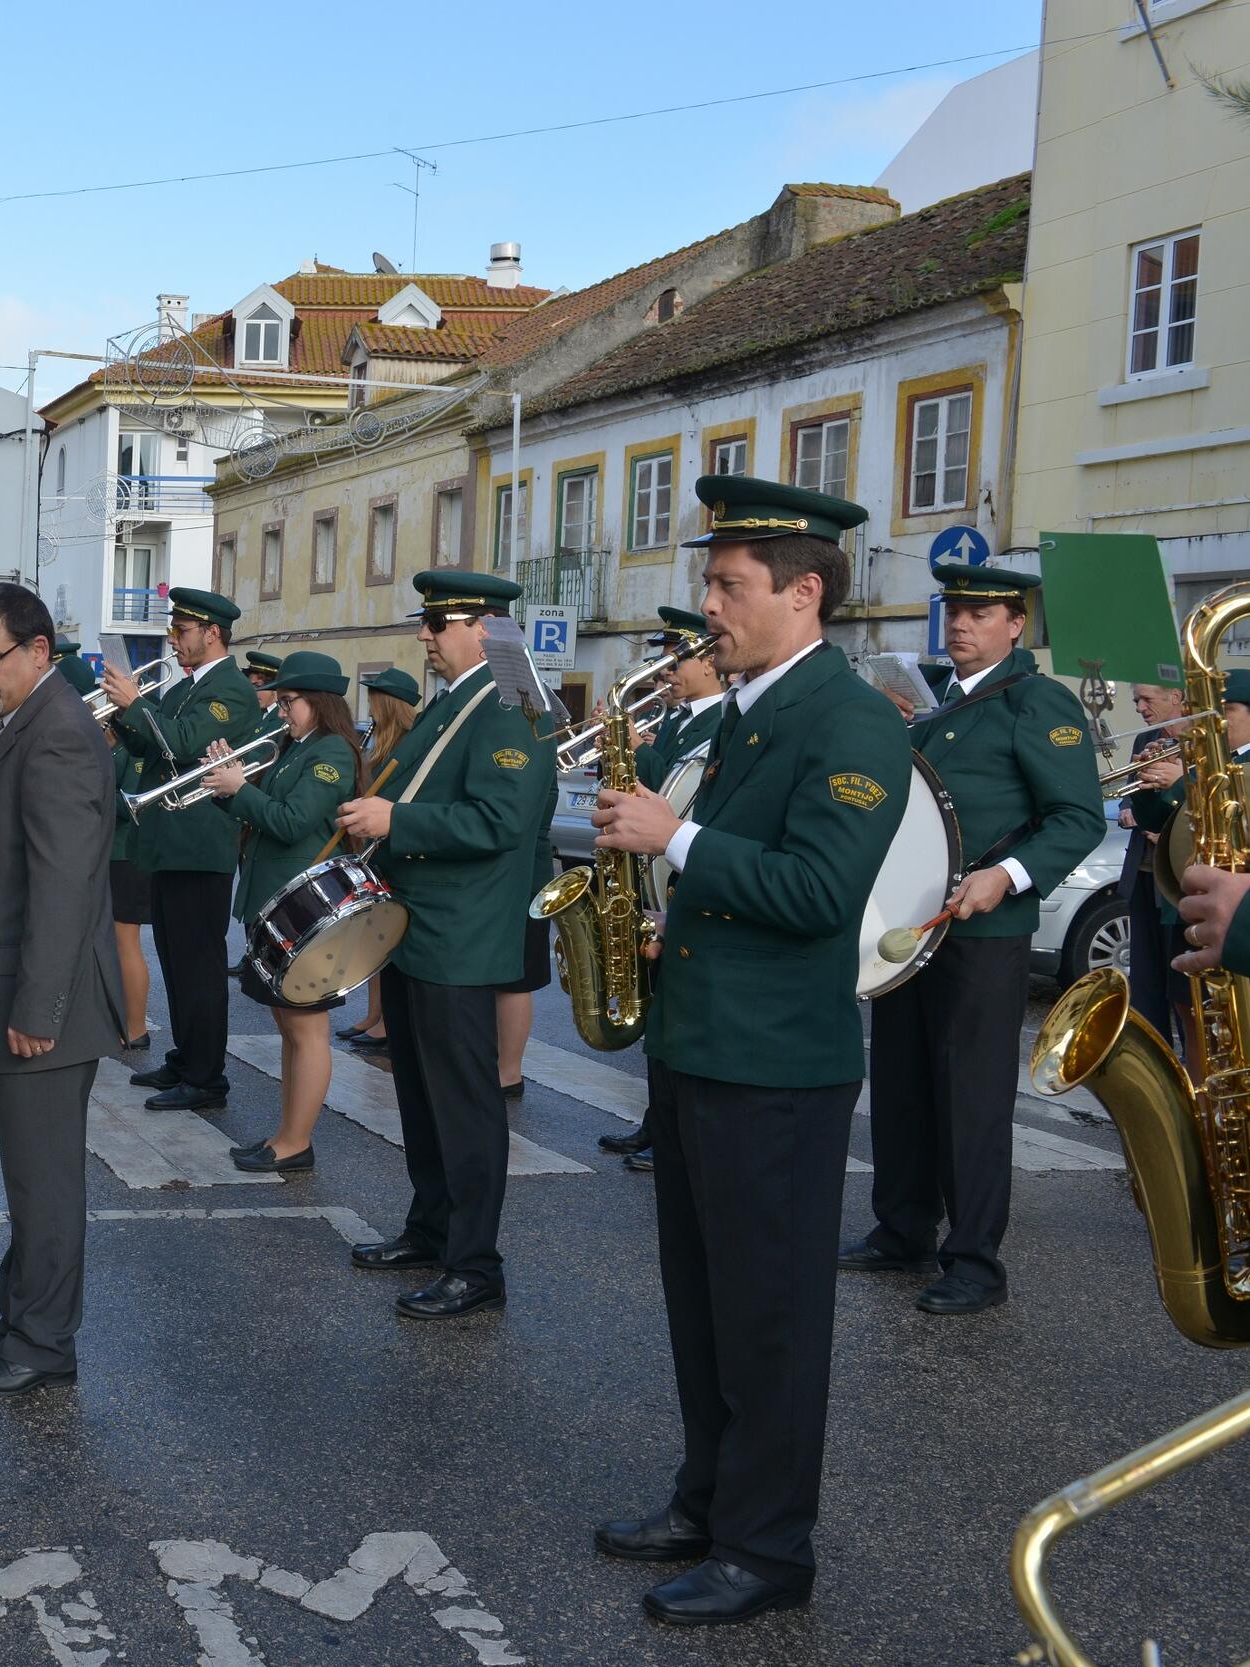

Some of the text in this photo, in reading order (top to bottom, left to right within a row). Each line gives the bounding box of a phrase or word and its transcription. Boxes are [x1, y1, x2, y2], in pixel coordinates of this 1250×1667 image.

[539, 609, 565, 617] zona
[541, 623, 561, 650] P
[832, 776, 849, 786] SOC.
[850, 776, 863, 786] FIL.
[838, 787, 874, 802] MONTIJO
[840, 795, 868, 806] PORTUGAL
